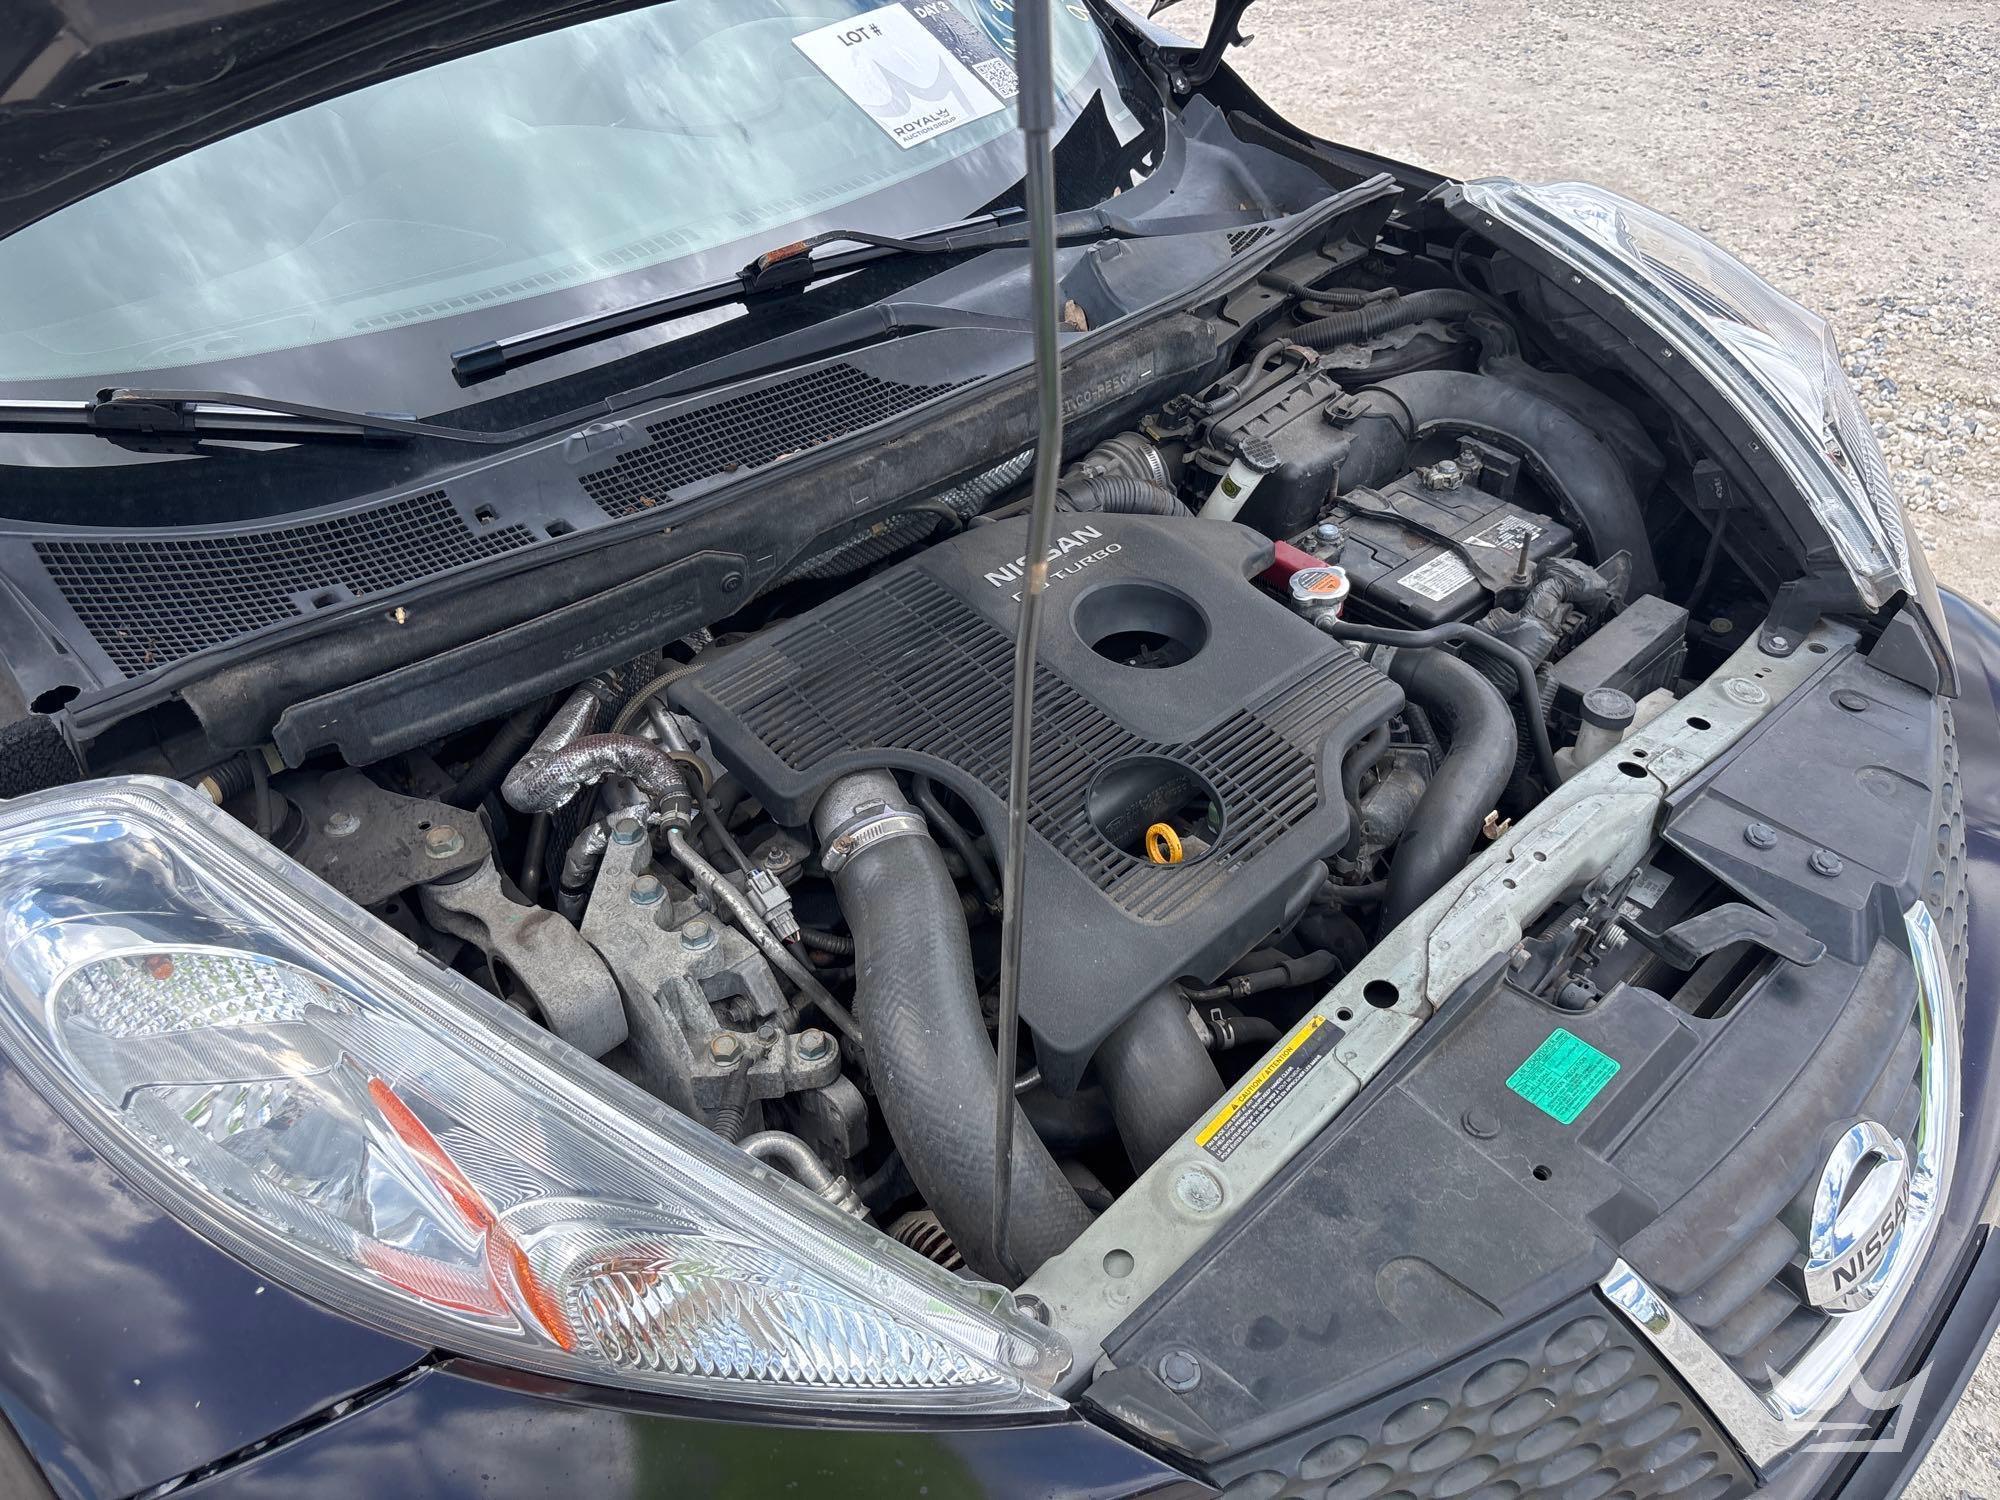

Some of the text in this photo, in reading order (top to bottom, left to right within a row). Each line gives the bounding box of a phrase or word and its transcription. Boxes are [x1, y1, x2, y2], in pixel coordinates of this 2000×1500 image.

[913, 1, 950, 19] DAY 3
[837, 23, 883, 47] LOT #
[893, 114, 941, 137] ROYAL
[902, 116, 957, 143] AUCTION GROUP
[983, 525, 1103, 588] NIAN
[1050, 543, 1122, 580] TURBO
[1237, 1077, 1263, 1102] CAUTION
[1263, 1046, 1293, 1075] ATTENTION
